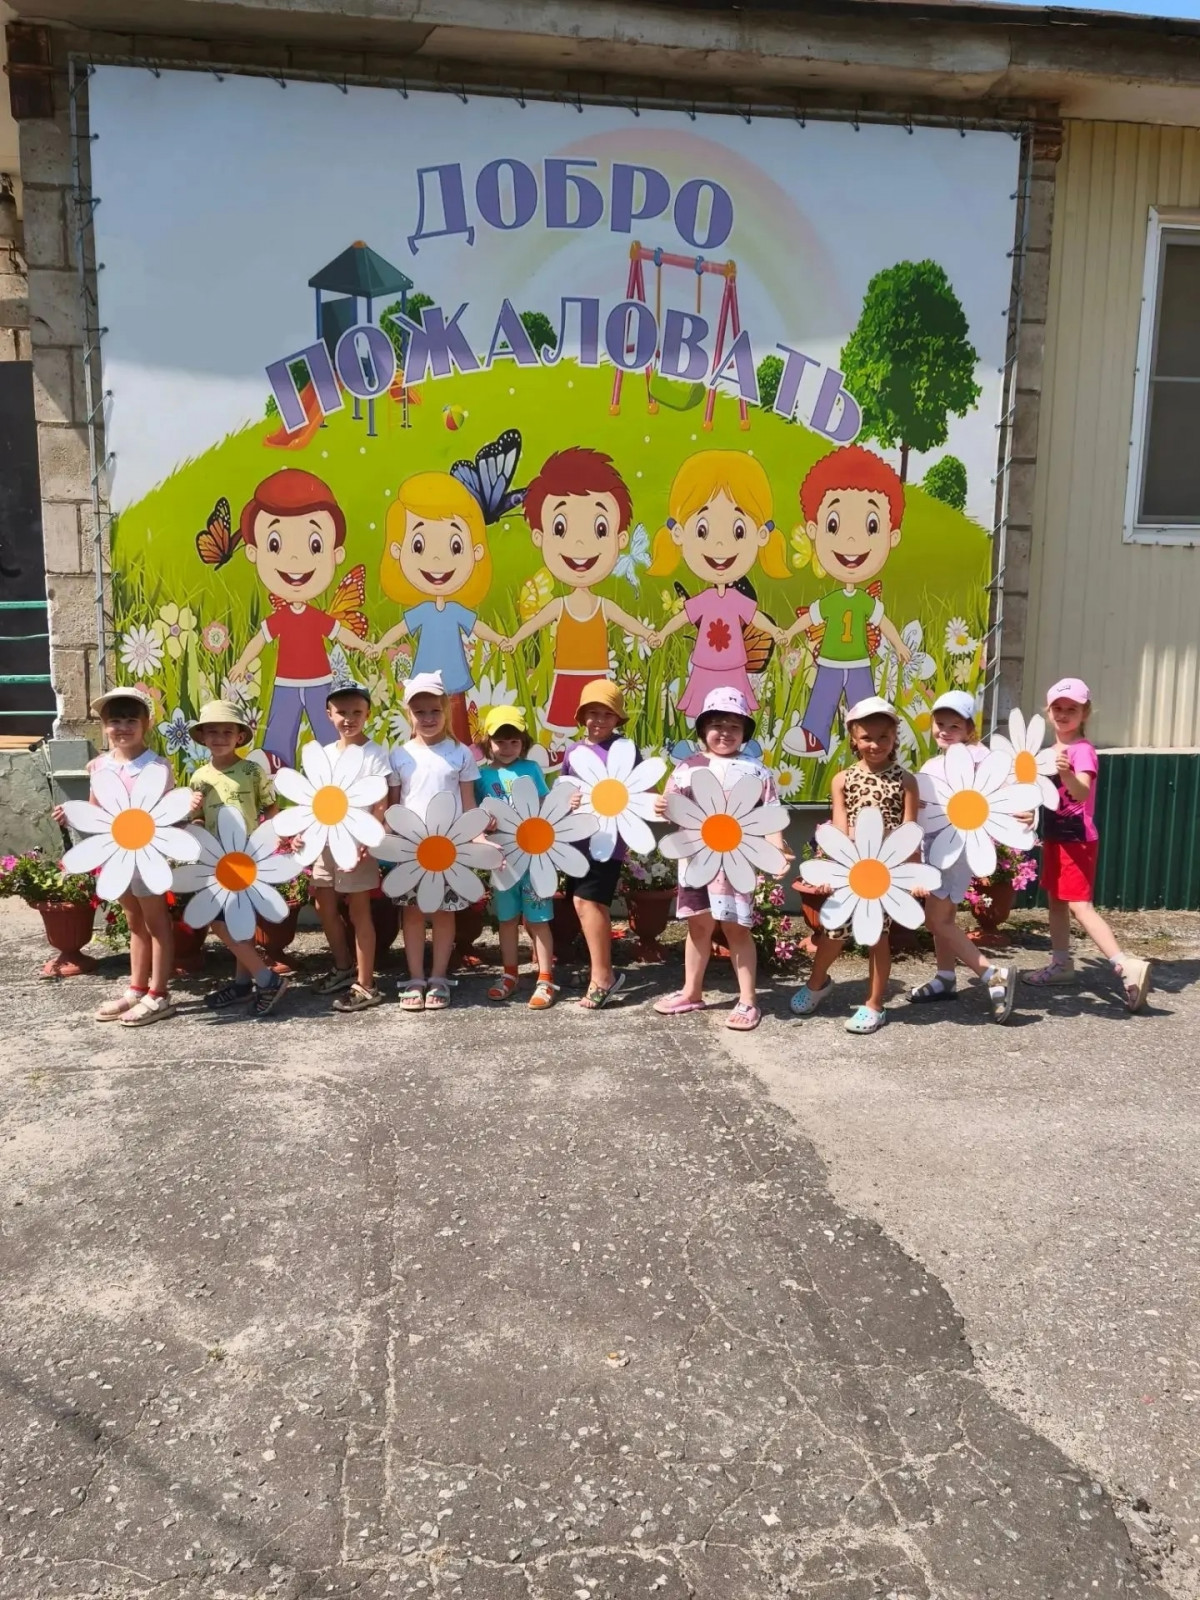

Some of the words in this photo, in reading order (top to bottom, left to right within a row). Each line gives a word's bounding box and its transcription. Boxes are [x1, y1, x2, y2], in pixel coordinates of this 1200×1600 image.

[407, 157, 734, 255] ДОБРО
[266, 297, 864, 442] ПОЖАЛОВАТЬ
[841, 609, 853, 643] 1
